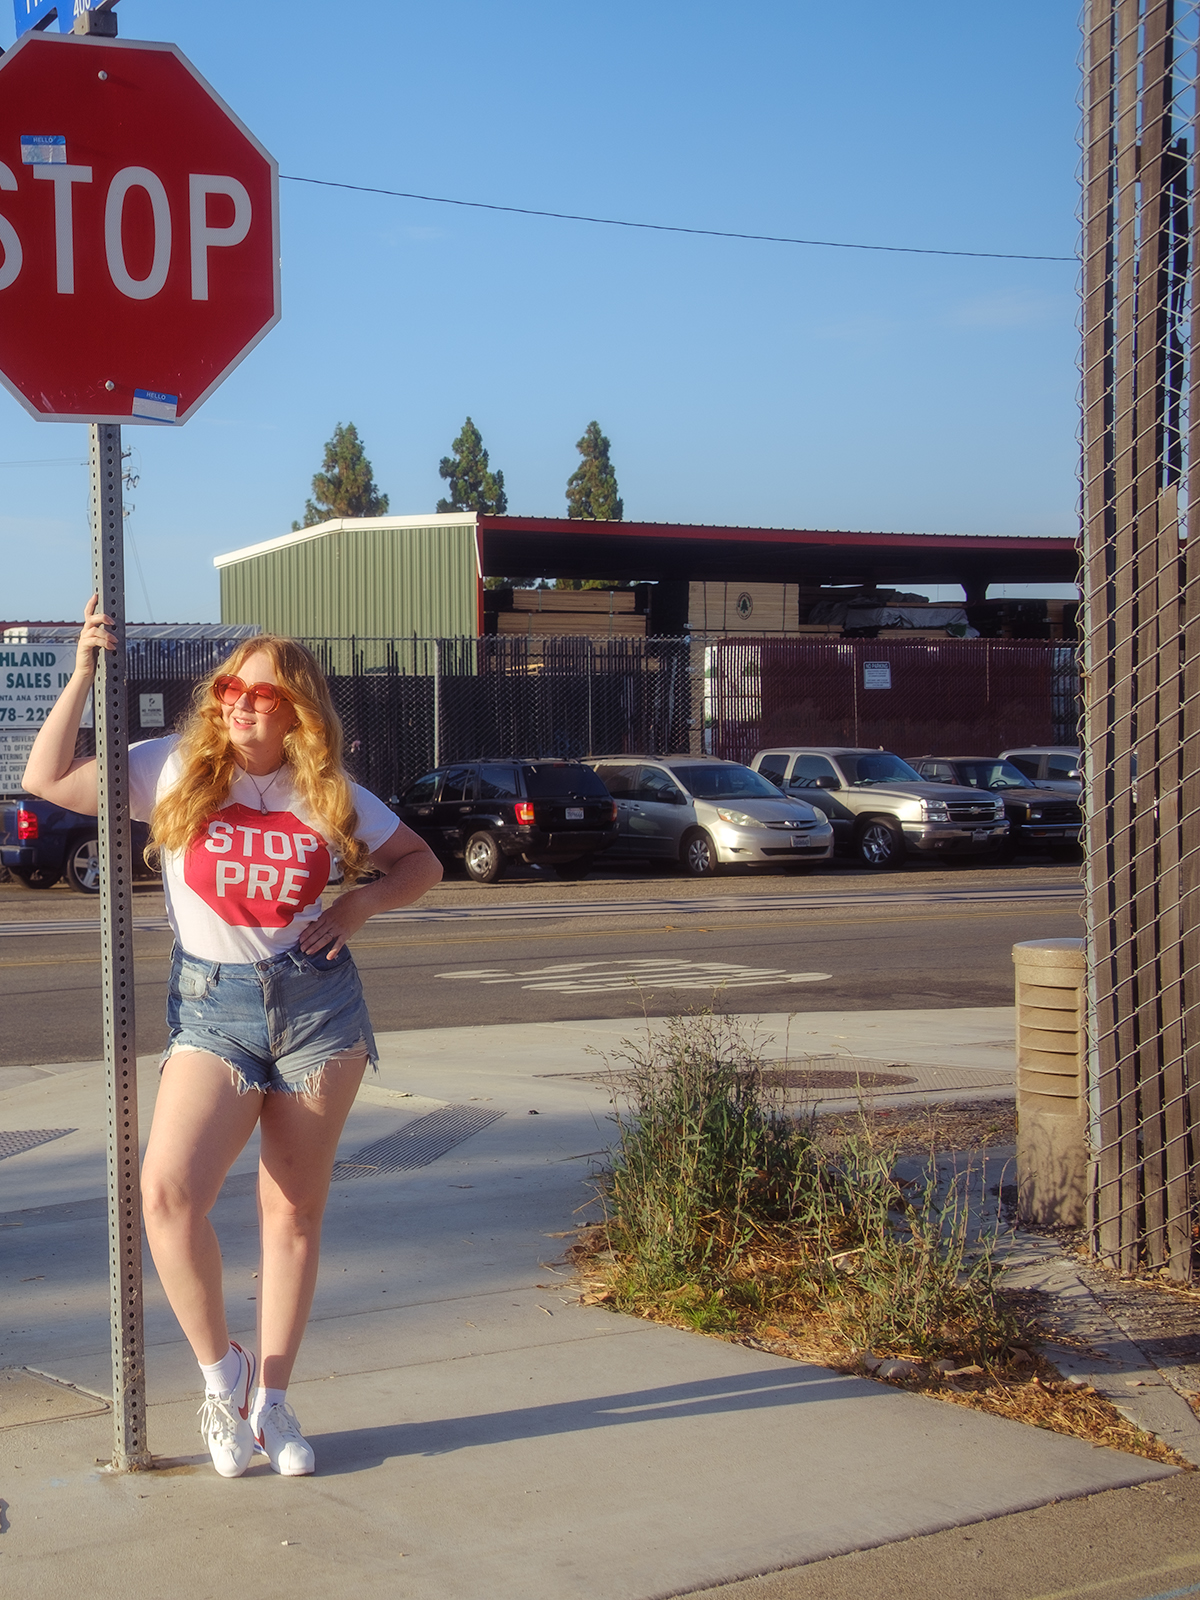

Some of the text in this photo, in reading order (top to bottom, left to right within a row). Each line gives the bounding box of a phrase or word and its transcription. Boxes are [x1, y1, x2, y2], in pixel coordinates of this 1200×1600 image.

[146, 391, 166, 400] HELLO
[6, 672, 51, 689] SALES
[58, 672, 73, 688] IN
[204, 820, 319, 864] STOP
[215, 860, 310, 906] PRE
